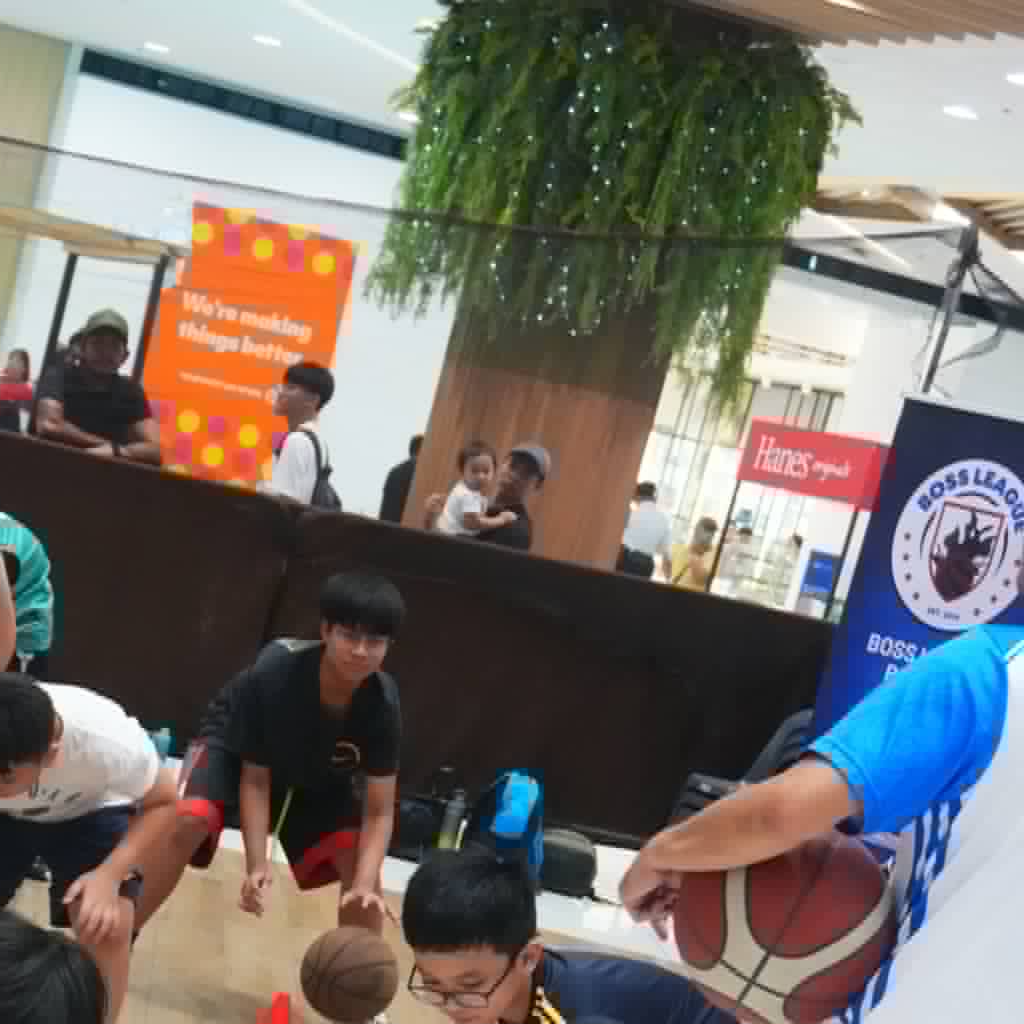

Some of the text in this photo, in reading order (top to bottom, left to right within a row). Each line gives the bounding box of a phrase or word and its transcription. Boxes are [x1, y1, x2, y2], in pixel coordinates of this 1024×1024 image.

[177, 321, 241, 353] things
[239, 311, 313, 345] making
[753, 433, 815, 480] Hanes
[916, 466, 1024, 535] BOSS LEAGUE
